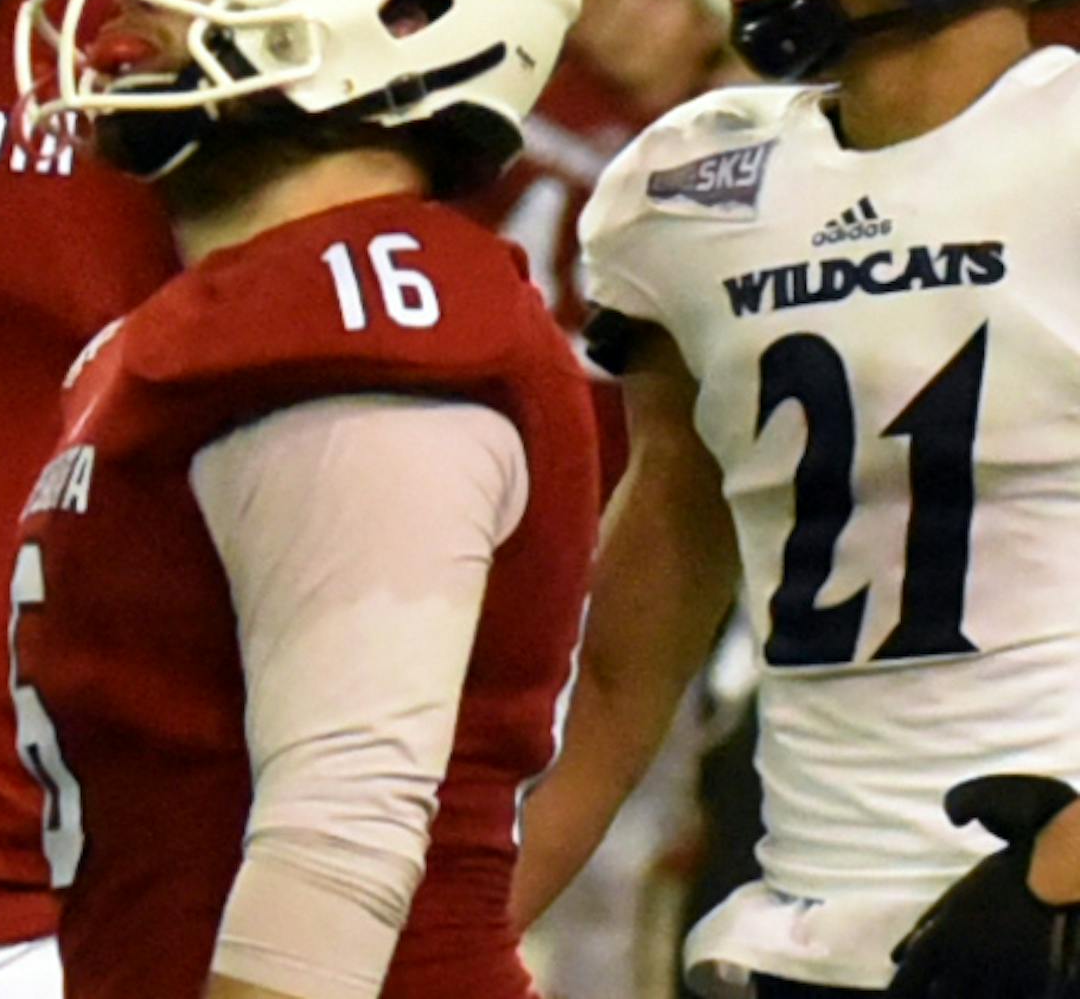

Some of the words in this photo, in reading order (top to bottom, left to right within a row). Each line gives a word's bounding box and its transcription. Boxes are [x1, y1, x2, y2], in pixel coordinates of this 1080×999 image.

[695, 146, 765, 192] SKY
[811, 218, 893, 247] adidas
[322, 231, 441, 332] 16
[723, 241, 1007, 318] WILDCATS
[754, 319, 989, 667] 21
